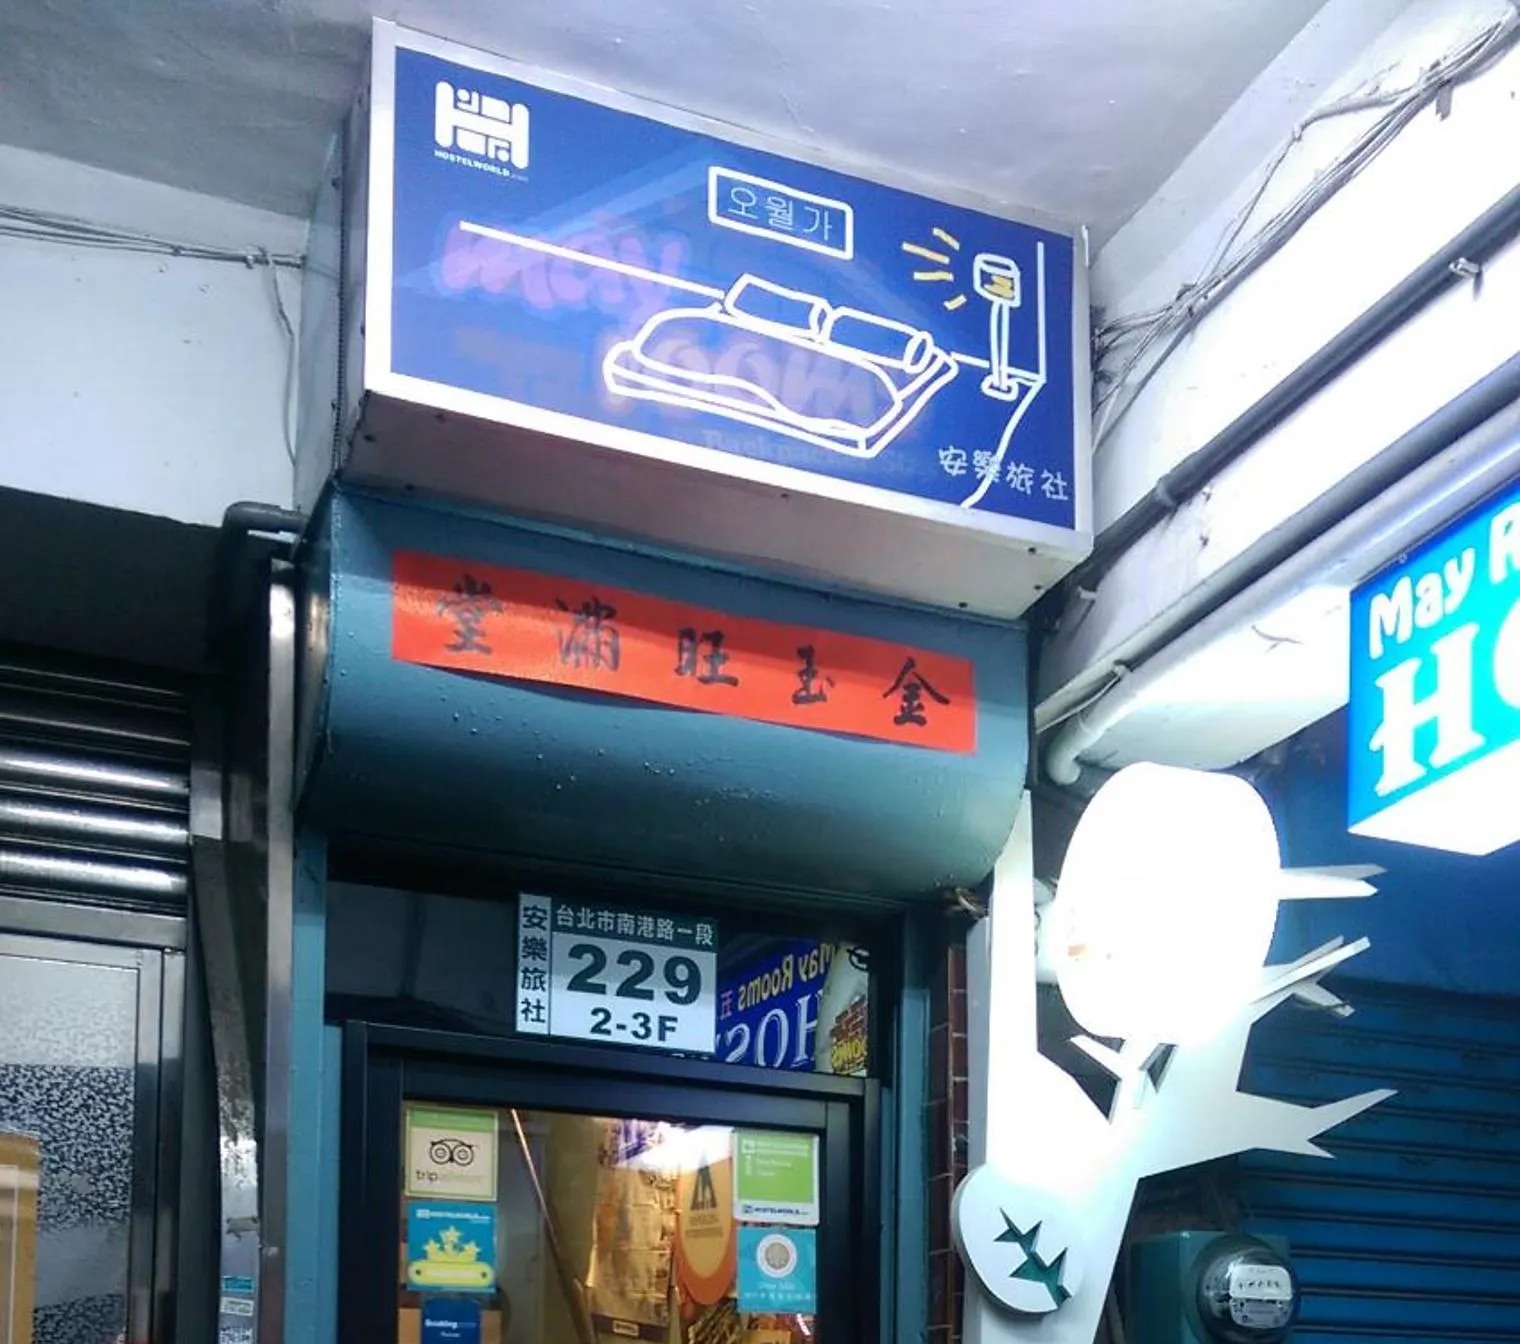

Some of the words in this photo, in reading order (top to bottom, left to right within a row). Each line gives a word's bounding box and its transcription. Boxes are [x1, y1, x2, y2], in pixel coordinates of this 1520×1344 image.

[728, 187, 832, 241] 오월가
[938, 446, 1068, 501] 安樂旅社
[1369, 547, 1475, 660] May
[556, 904, 714, 947] 台北市南港路一段
[520, 904, 549, 1024] 安樂旅社
[566, 942, 702, 1006] 229
[589, 1006, 679, 1042] 2-3F
